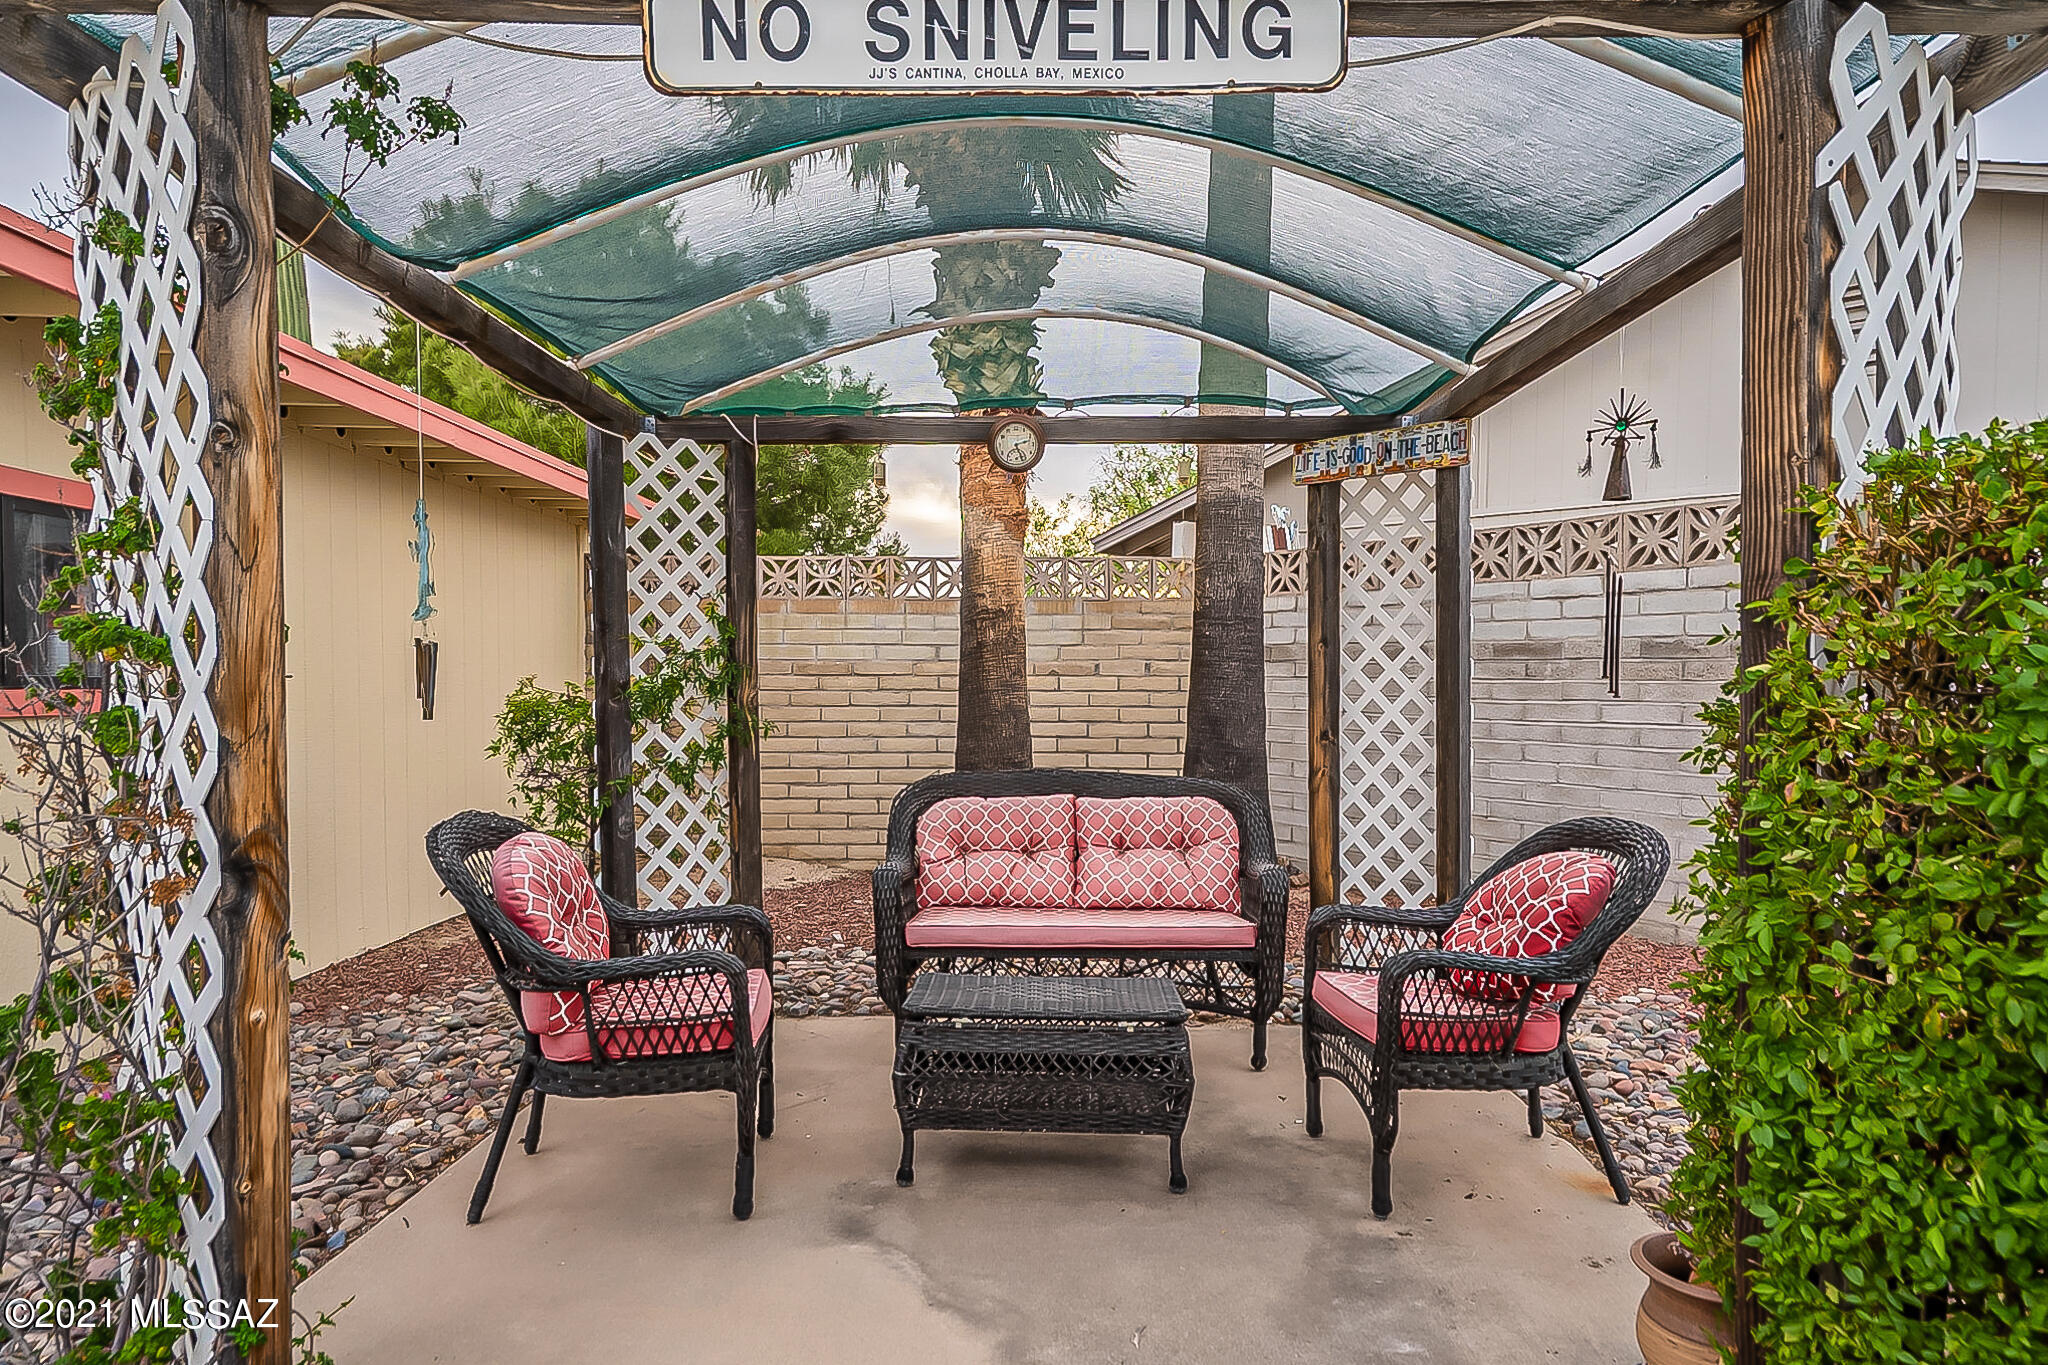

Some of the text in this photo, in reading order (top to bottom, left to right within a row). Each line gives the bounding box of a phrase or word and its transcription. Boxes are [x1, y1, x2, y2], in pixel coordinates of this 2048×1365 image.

[701, 0, 1292, 62] NO SNIVELING
[868, 67, 1125, 80] JJ'S CANTINA, CHOLLA BAY, MEXICO
